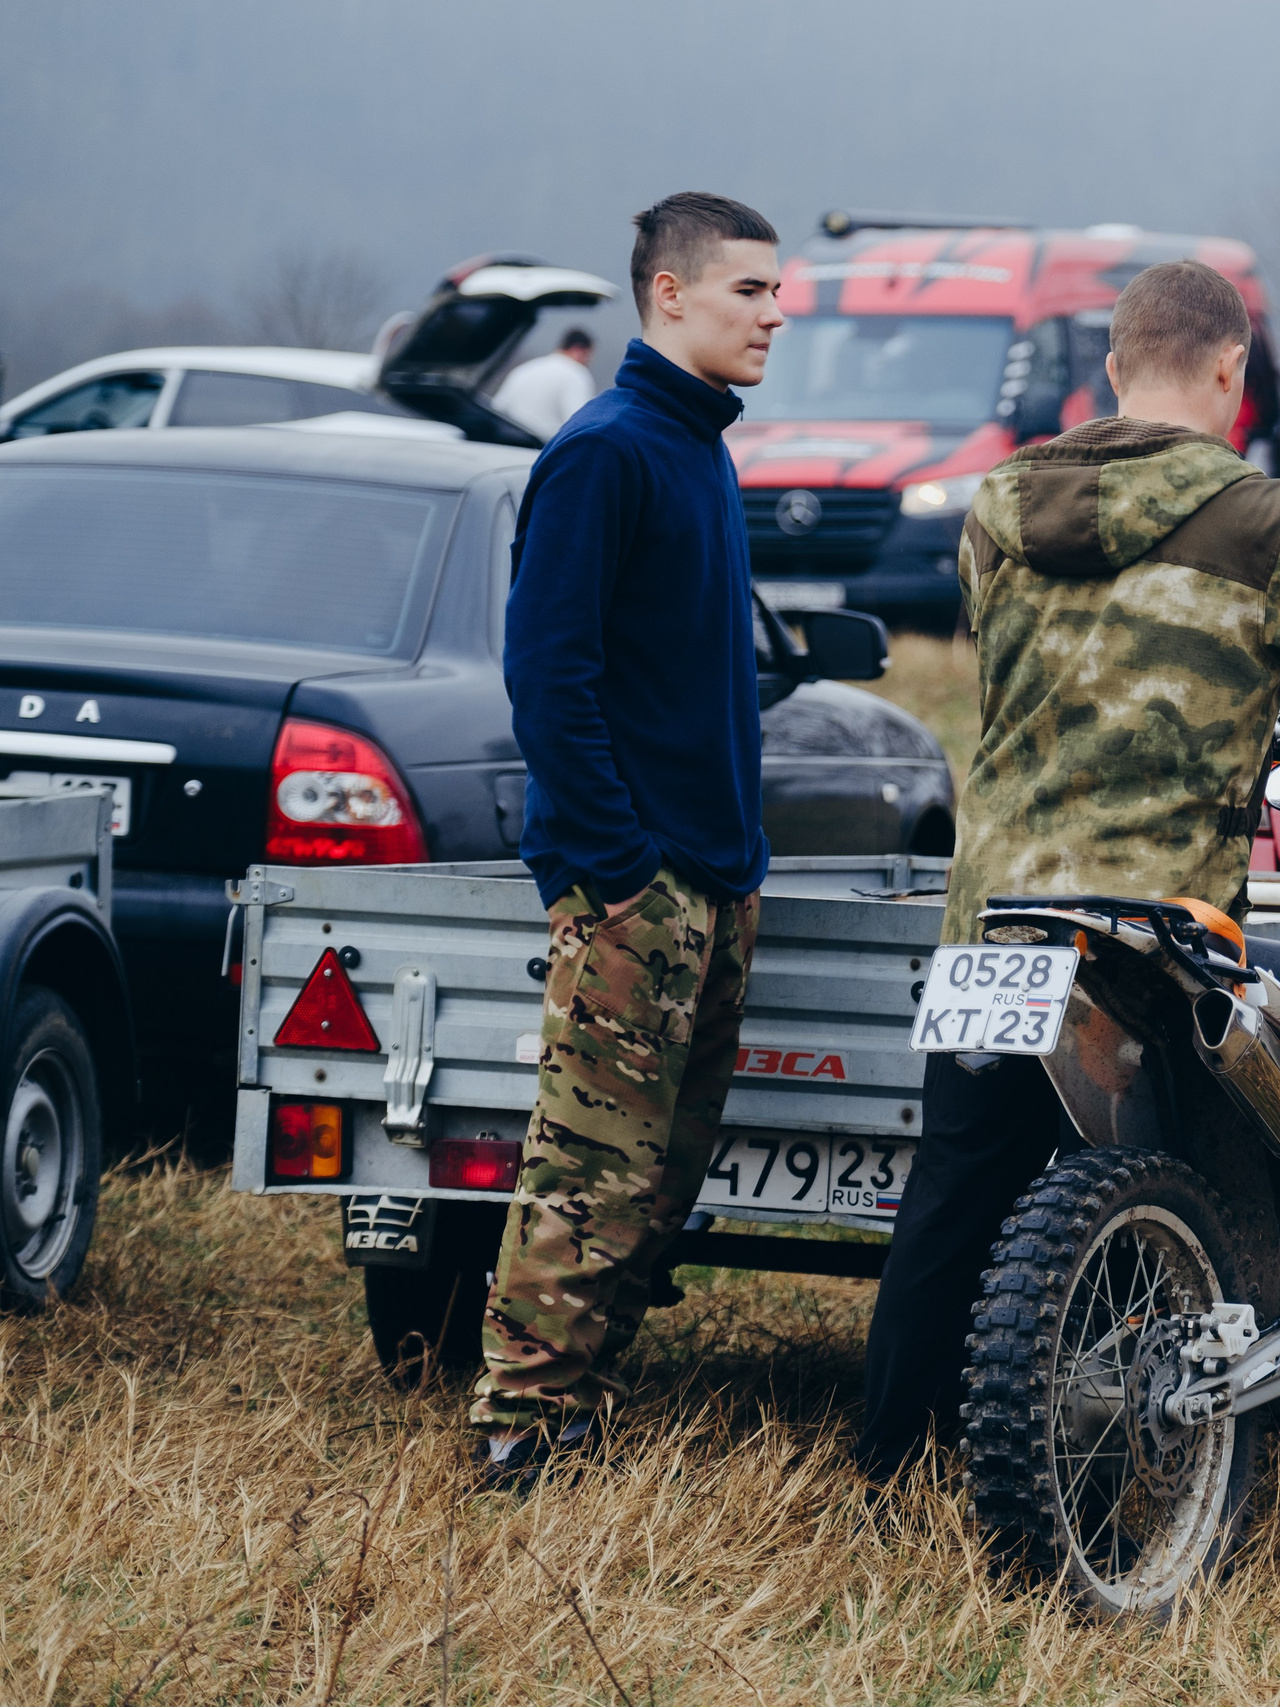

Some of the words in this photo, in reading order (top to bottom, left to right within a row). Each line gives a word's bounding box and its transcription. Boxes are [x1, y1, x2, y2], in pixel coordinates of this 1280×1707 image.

[950, 953, 1053, 988] 0528
[992, 993, 1025, 1005] RUS
[919, 1008, 982, 1044] КТ
[993, 1010, 1050, 1046] 23
[707, 1136, 819, 1201] 479
[837, 1140, 895, 1190] 23
[832, 1189, 873, 1208] RUS
